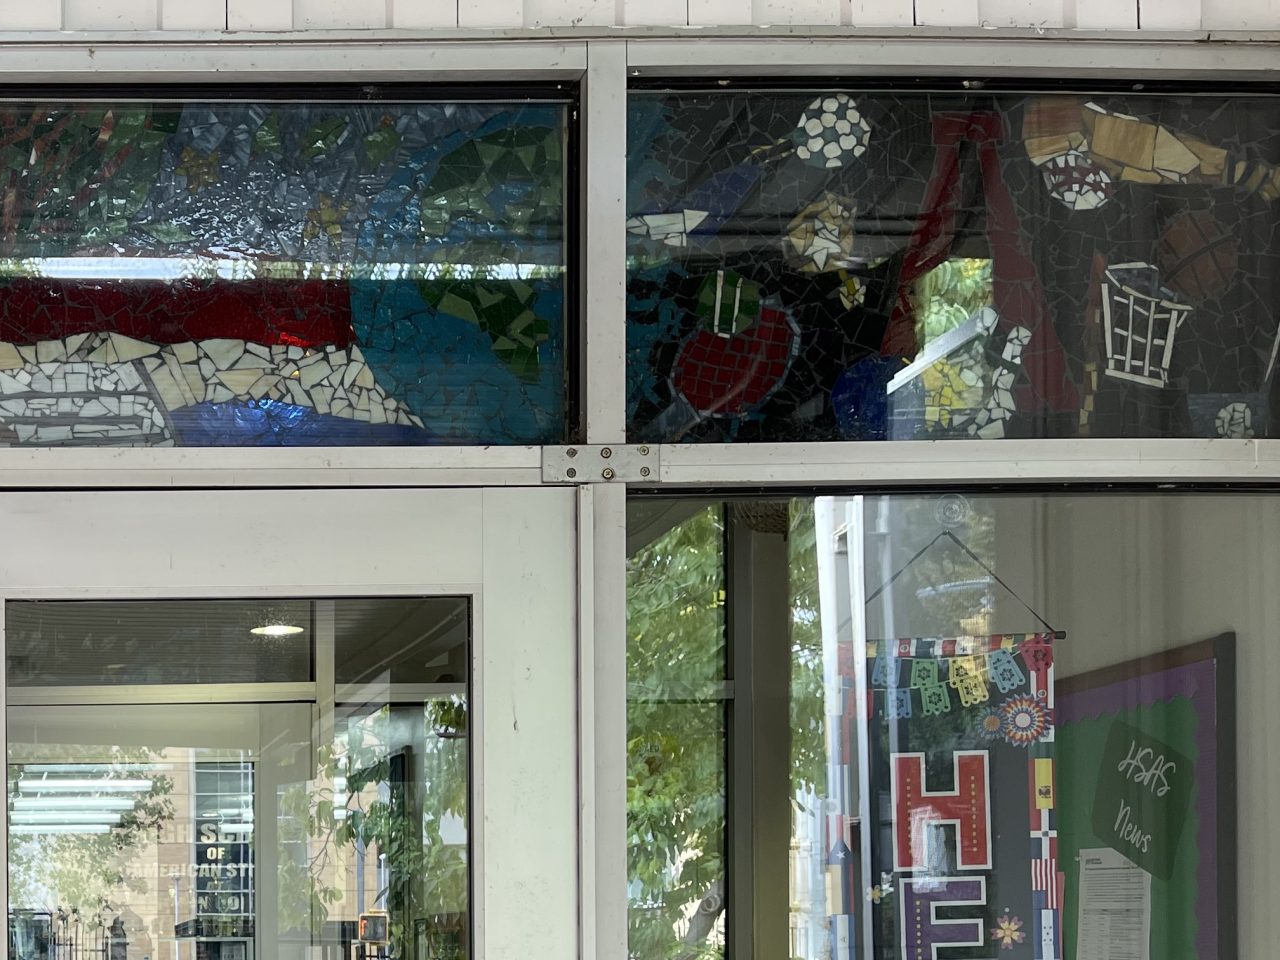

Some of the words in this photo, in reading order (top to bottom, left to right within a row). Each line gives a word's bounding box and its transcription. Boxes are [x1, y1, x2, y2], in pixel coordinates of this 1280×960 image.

[1117, 739, 1176, 797] HSAS
[206, 846, 226, 860] OF
[1114, 798, 1152, 853] News
